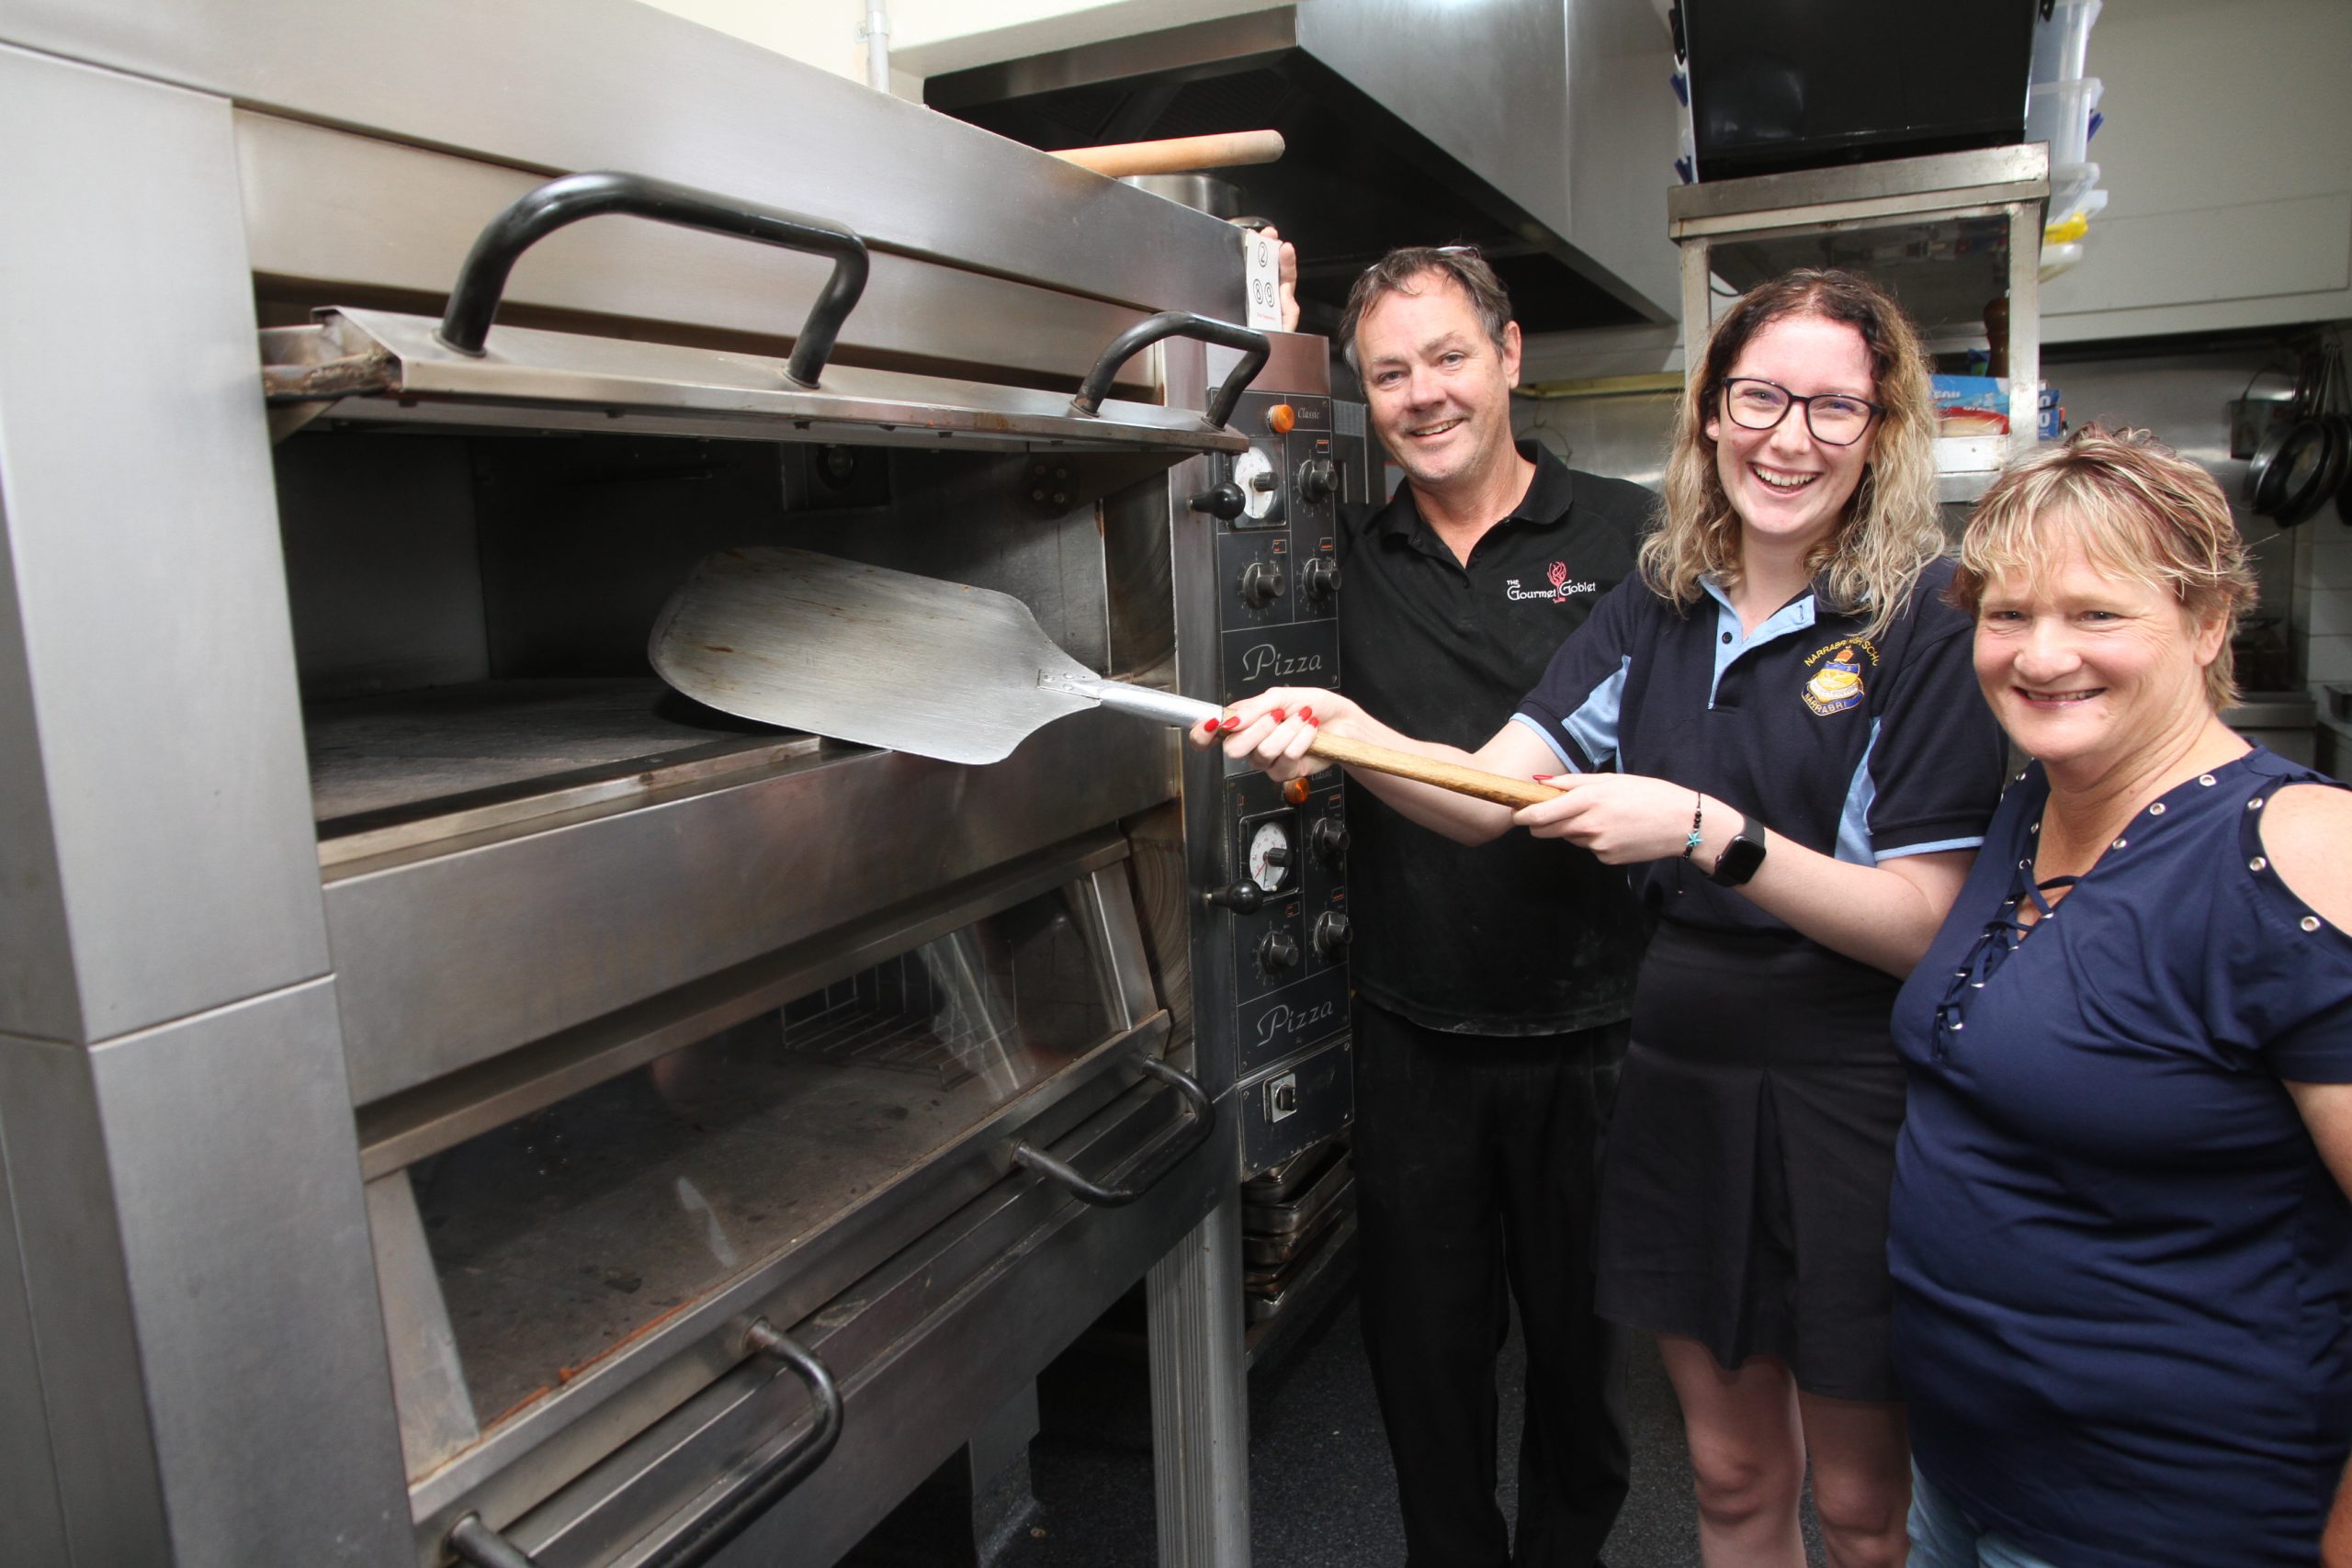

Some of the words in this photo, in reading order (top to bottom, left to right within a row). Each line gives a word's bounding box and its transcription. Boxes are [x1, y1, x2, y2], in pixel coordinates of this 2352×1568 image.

[1297, 406, 1321, 420] Classic
[1507, 584, 1556, 601] Gourmet
[1559, 580, 1596, 596] Goblet
[1242, 643, 1322, 682] Pizza
[1804, 693, 1847, 714] NARRABRI
[1257, 1000, 1333, 1047] Pizza
